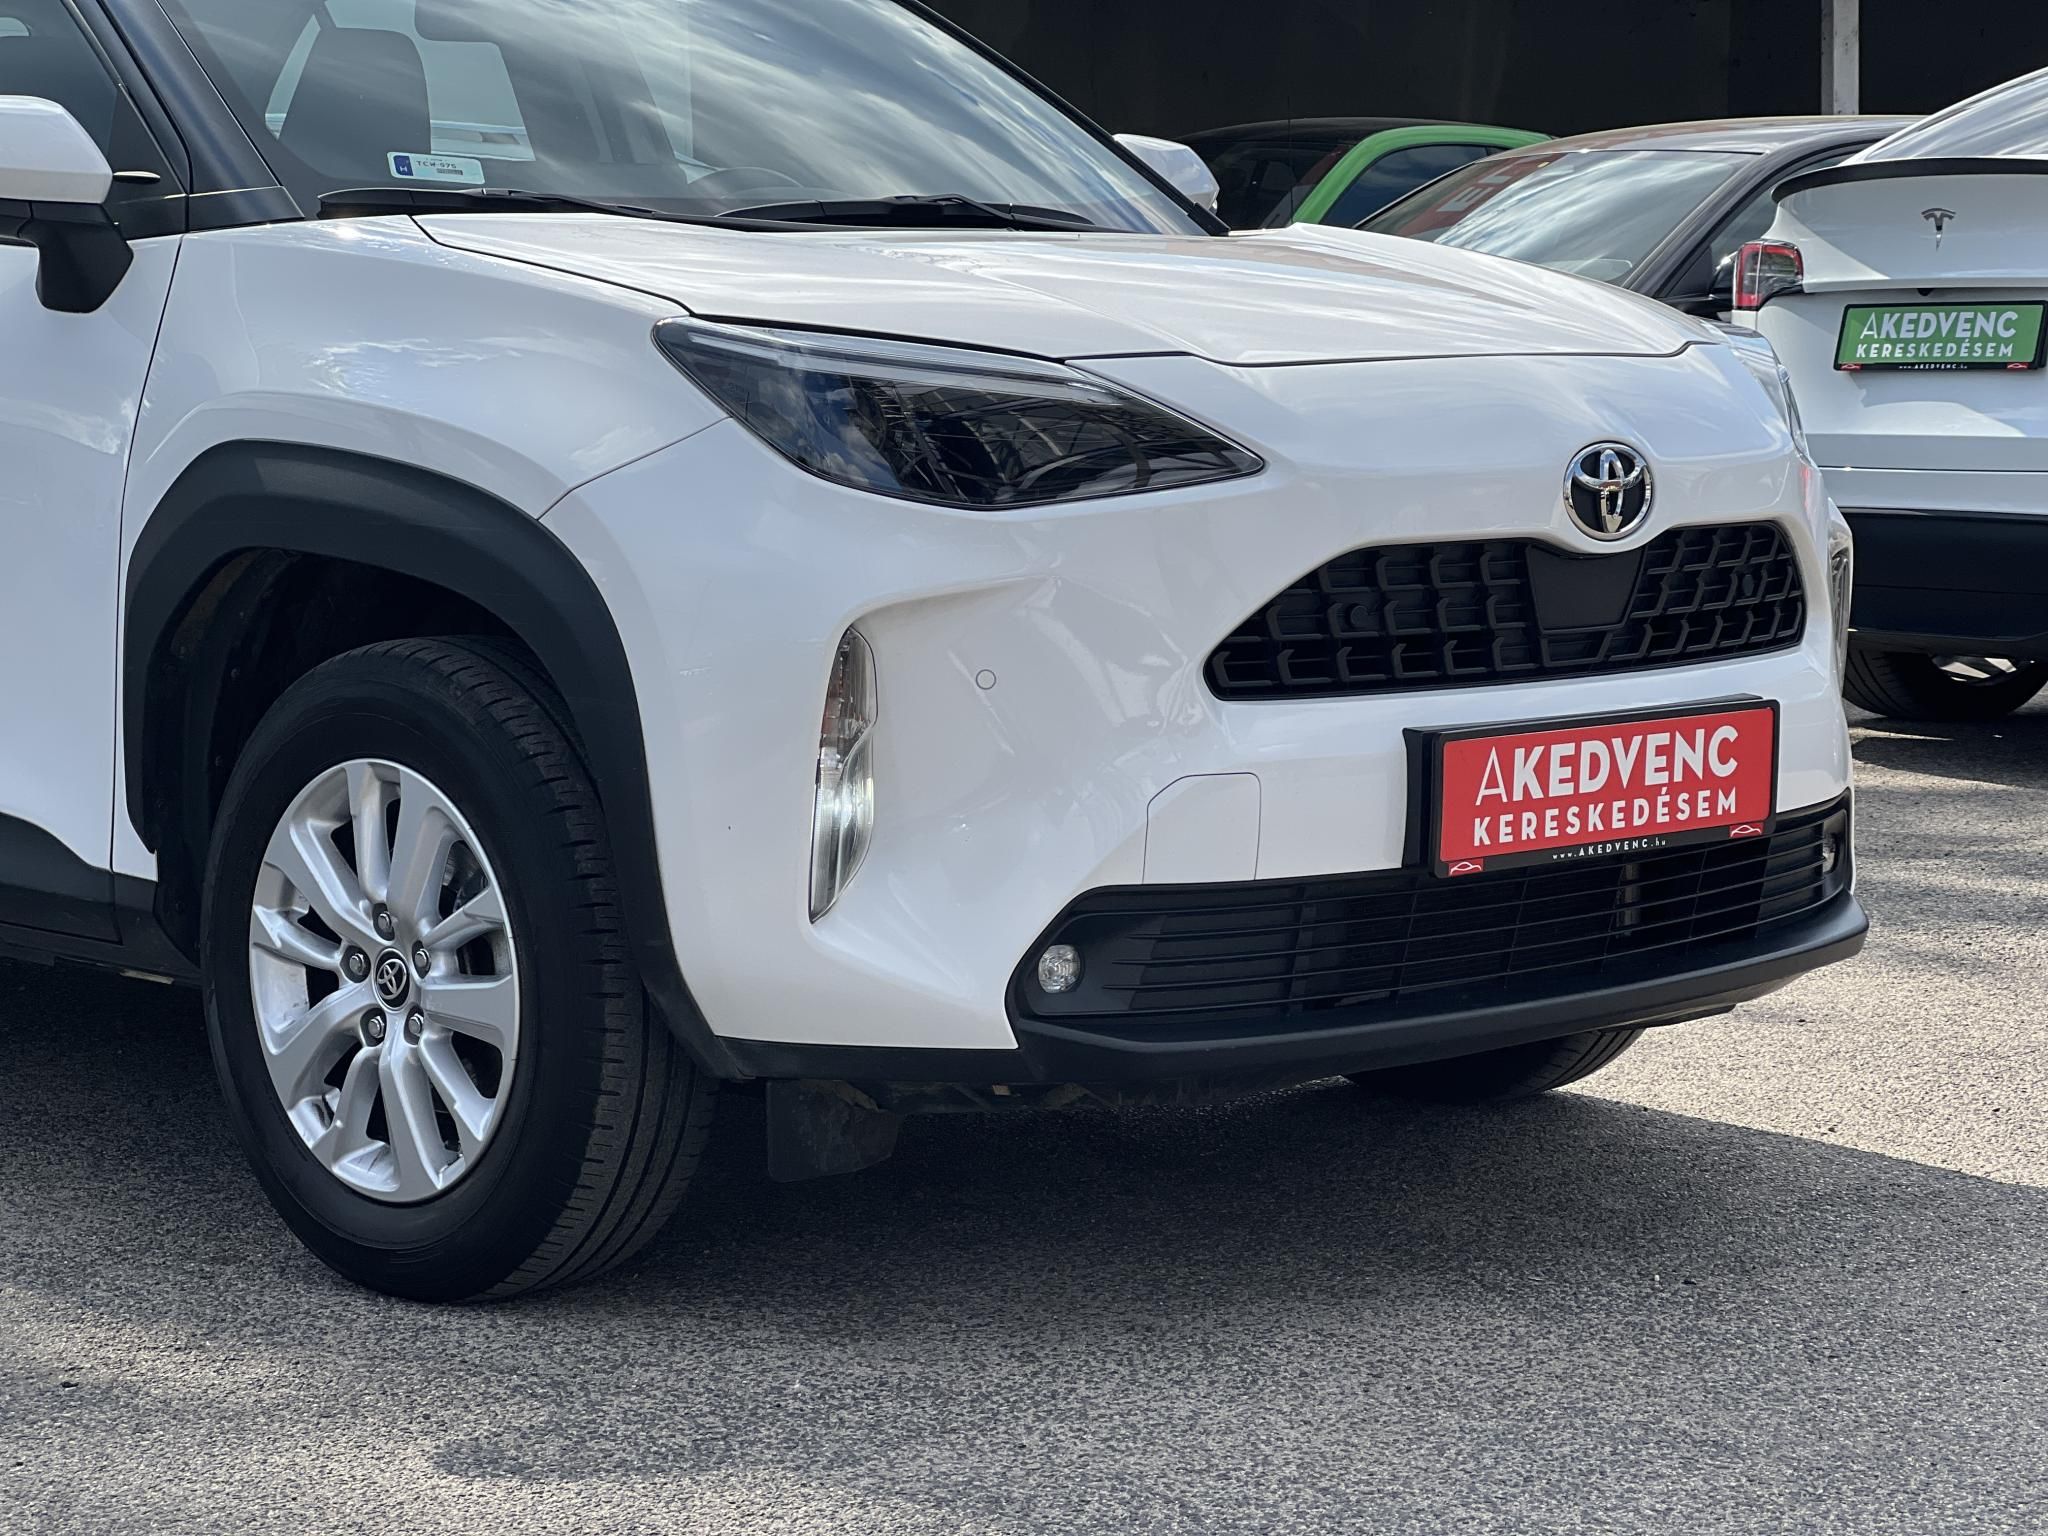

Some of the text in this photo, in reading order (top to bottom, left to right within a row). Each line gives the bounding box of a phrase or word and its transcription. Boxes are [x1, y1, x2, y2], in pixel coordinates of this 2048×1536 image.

[1860, 311, 2018, 339] AKEDVENC
[1856, 339, 2013, 358] KERESKEDÉSEM
[1475, 725, 1739, 806] AKEDVENC
[1473, 786, 1736, 846] KERESKEDÉSEM
[1552, 837, 1666, 860] www.AKEDVENC.hu
